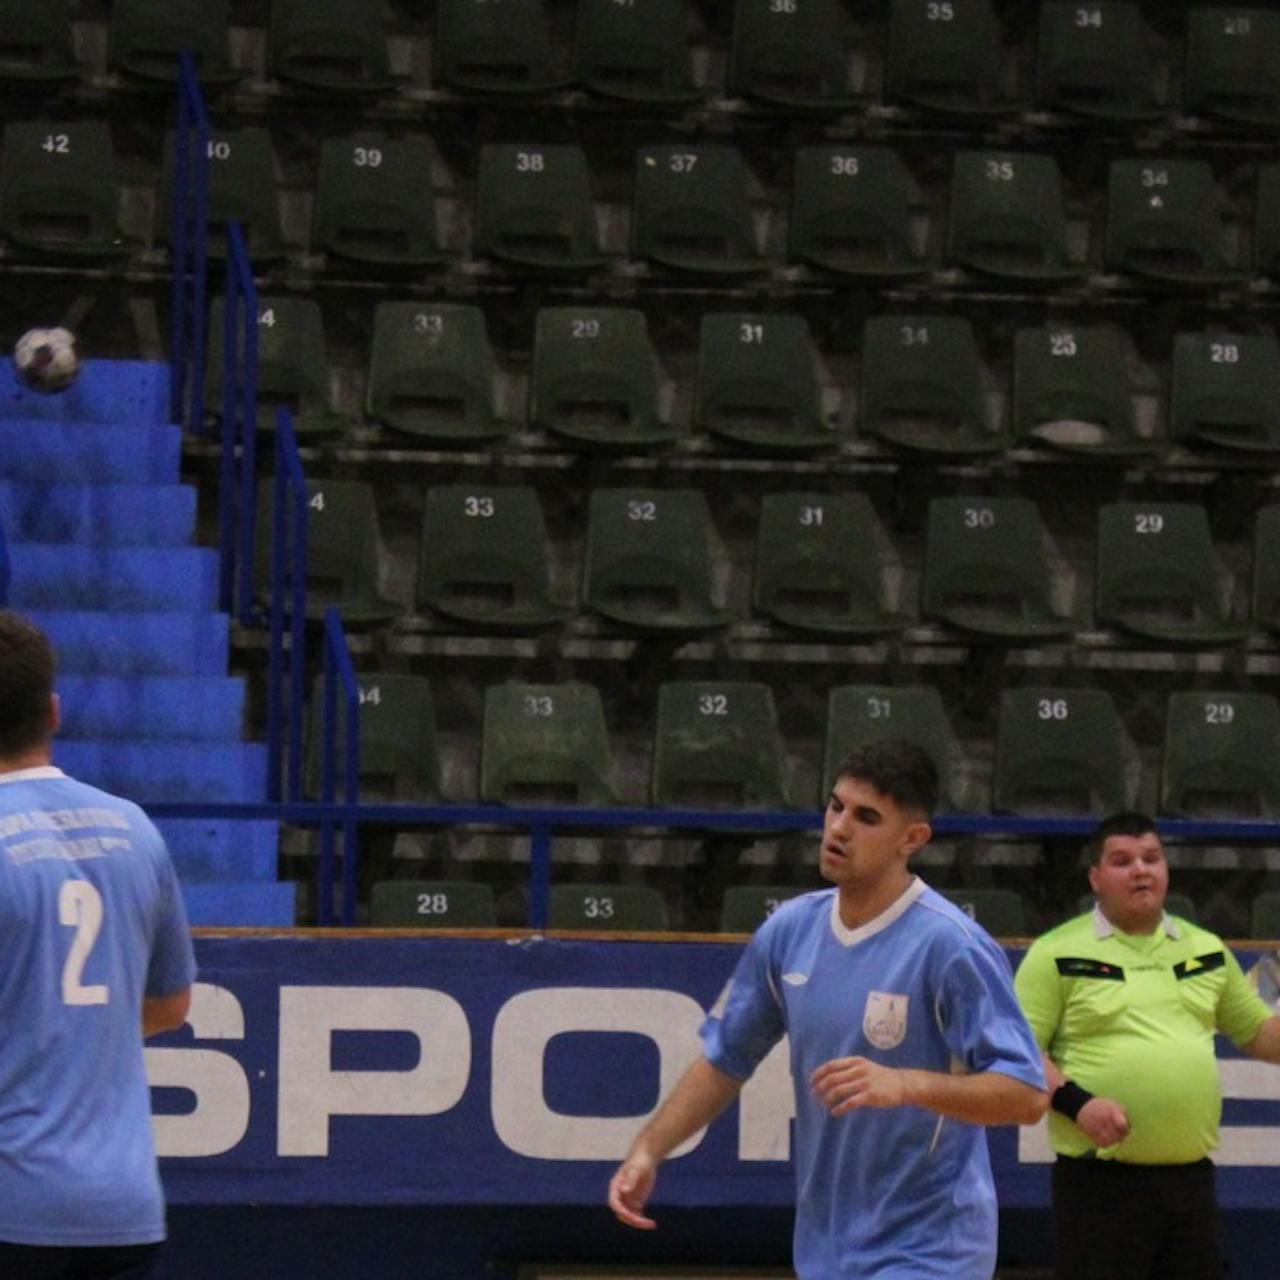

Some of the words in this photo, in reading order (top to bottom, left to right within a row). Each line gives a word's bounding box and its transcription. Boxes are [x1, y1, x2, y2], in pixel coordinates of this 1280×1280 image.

[927, 3, 955, 21] 35
[1074, 9, 1102, 27] 34
[42, 134, 69, 153] 42
[354, 147, 382, 167] 39
[516, 152, 544, 172] 38
[670, 154, 698, 172] 37
[831, 155, 858, 175] 36
[986, 160, 1014, 181] 35
[1142, 168, 1168, 187] 34
[258, 308, 276, 328] 4
[414, 314, 443, 333] 33
[740, 323, 763, 343] 31
[900, 325, 928, 345] 34
[1211, 343, 1238, 363] 28
[308, 491, 325, 511] 4
[465, 496, 494, 516] 33
[628, 501, 656, 521] 32
[799, 506, 823, 525] 31
[964, 508, 995, 528] 30
[1135, 514, 1163, 533] 29
[523, 696, 553, 716] 33
[699, 694, 728, 715] 32
[867, 697, 891, 718] 31
[1038, 699, 1068, 720] 36
[1205, 703, 1234, 724] 29
[417, 893, 448, 914] 28
[583, 897, 615, 918] 33
[58, 879, 109, 1005] 2
